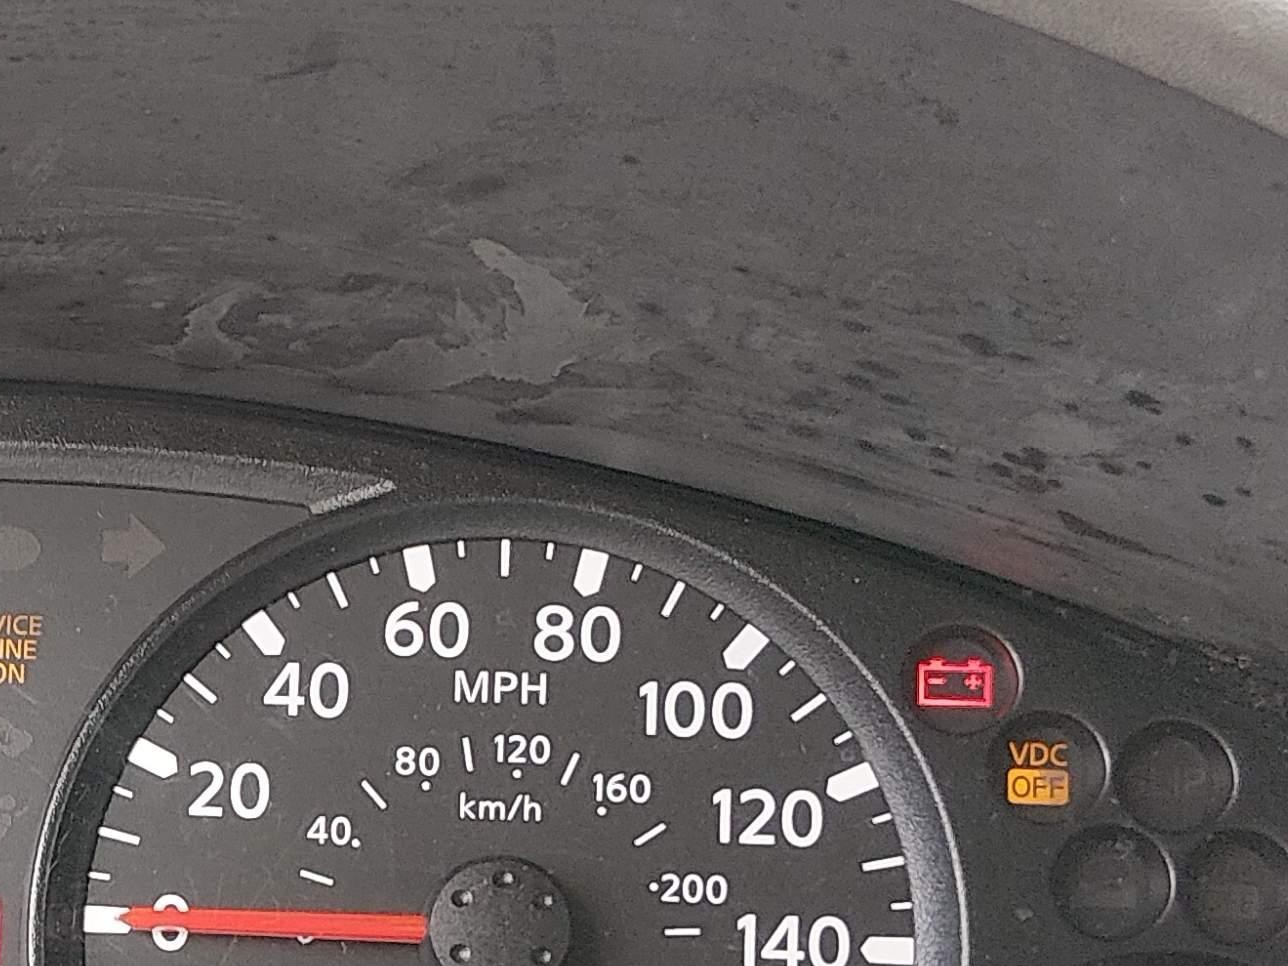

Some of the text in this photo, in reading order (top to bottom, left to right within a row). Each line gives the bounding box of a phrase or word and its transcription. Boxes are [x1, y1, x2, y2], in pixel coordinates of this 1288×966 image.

[383, 601, 471, 658] 60
[533, 604, 622, 663] 80
[264, 661, 350, 718] 40
[453, 670, 549, 706] MPH
[637, 680, 754, 740] 100
[394, 746, 441, 778] 80
[493, 733, 552, 766] 120
[1009, 742, 1069, 767] VDC
[187, 762, 271, 820] 20
[592, 772, 652, 805] 160
[1012, 775, 1065, 799] OFF
[458, 792, 543, 824] km/h
[712, 788, 824, 848] 120
[306, 816, 351, 846] 40
[659, 874, 728, 905] 200
[152, 893, 189, 952] 0
